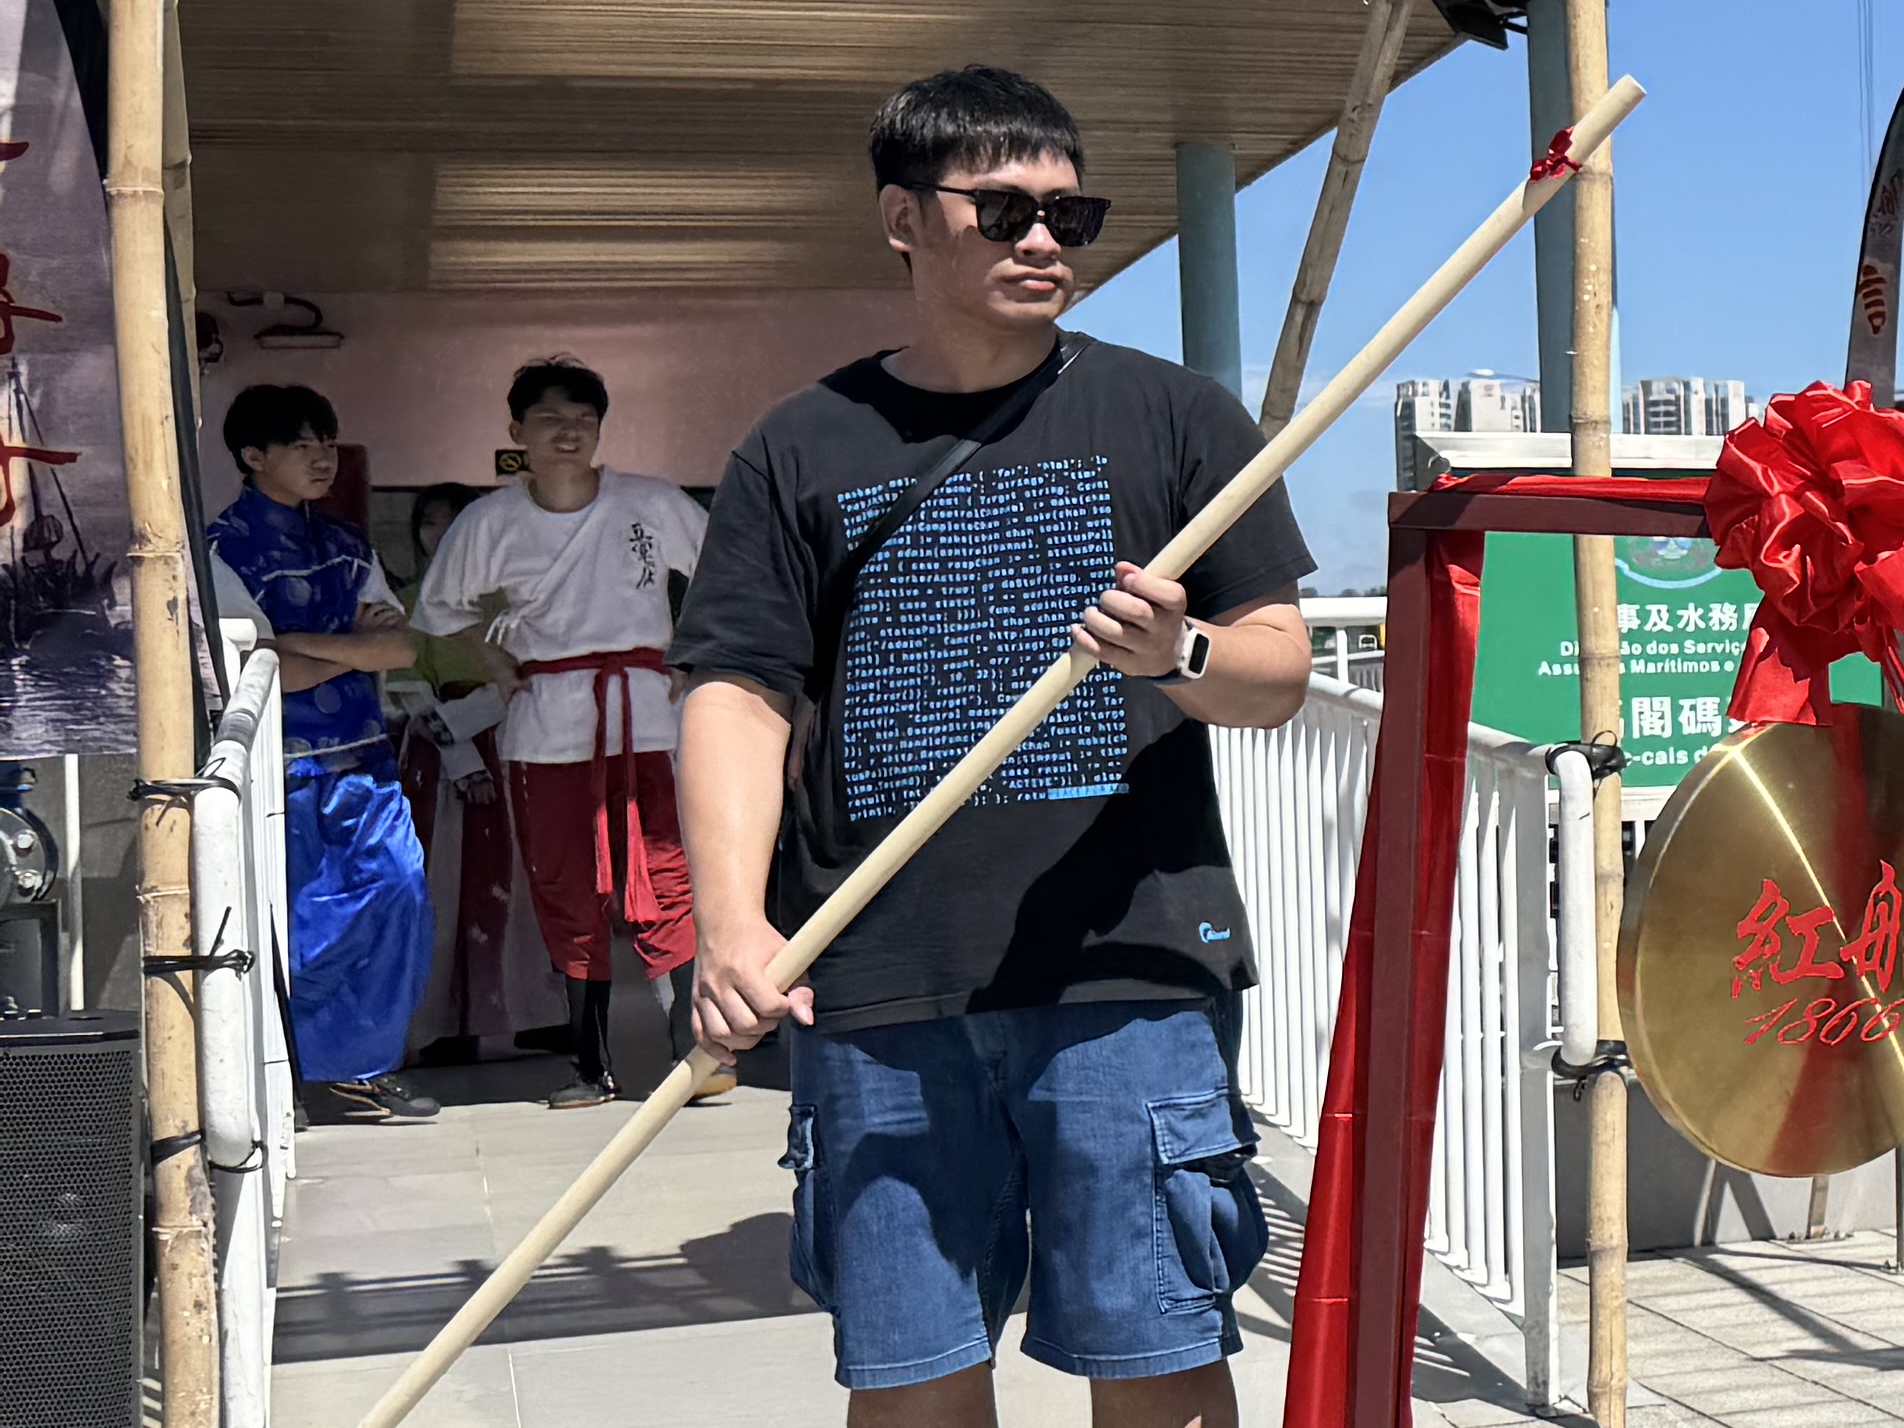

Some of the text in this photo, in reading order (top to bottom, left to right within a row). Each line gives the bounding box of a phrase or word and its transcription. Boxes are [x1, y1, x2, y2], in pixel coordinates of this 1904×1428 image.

[1646, 639, 1679, 655] dos
[1630, 657, 1735, 674] Marítimos e
